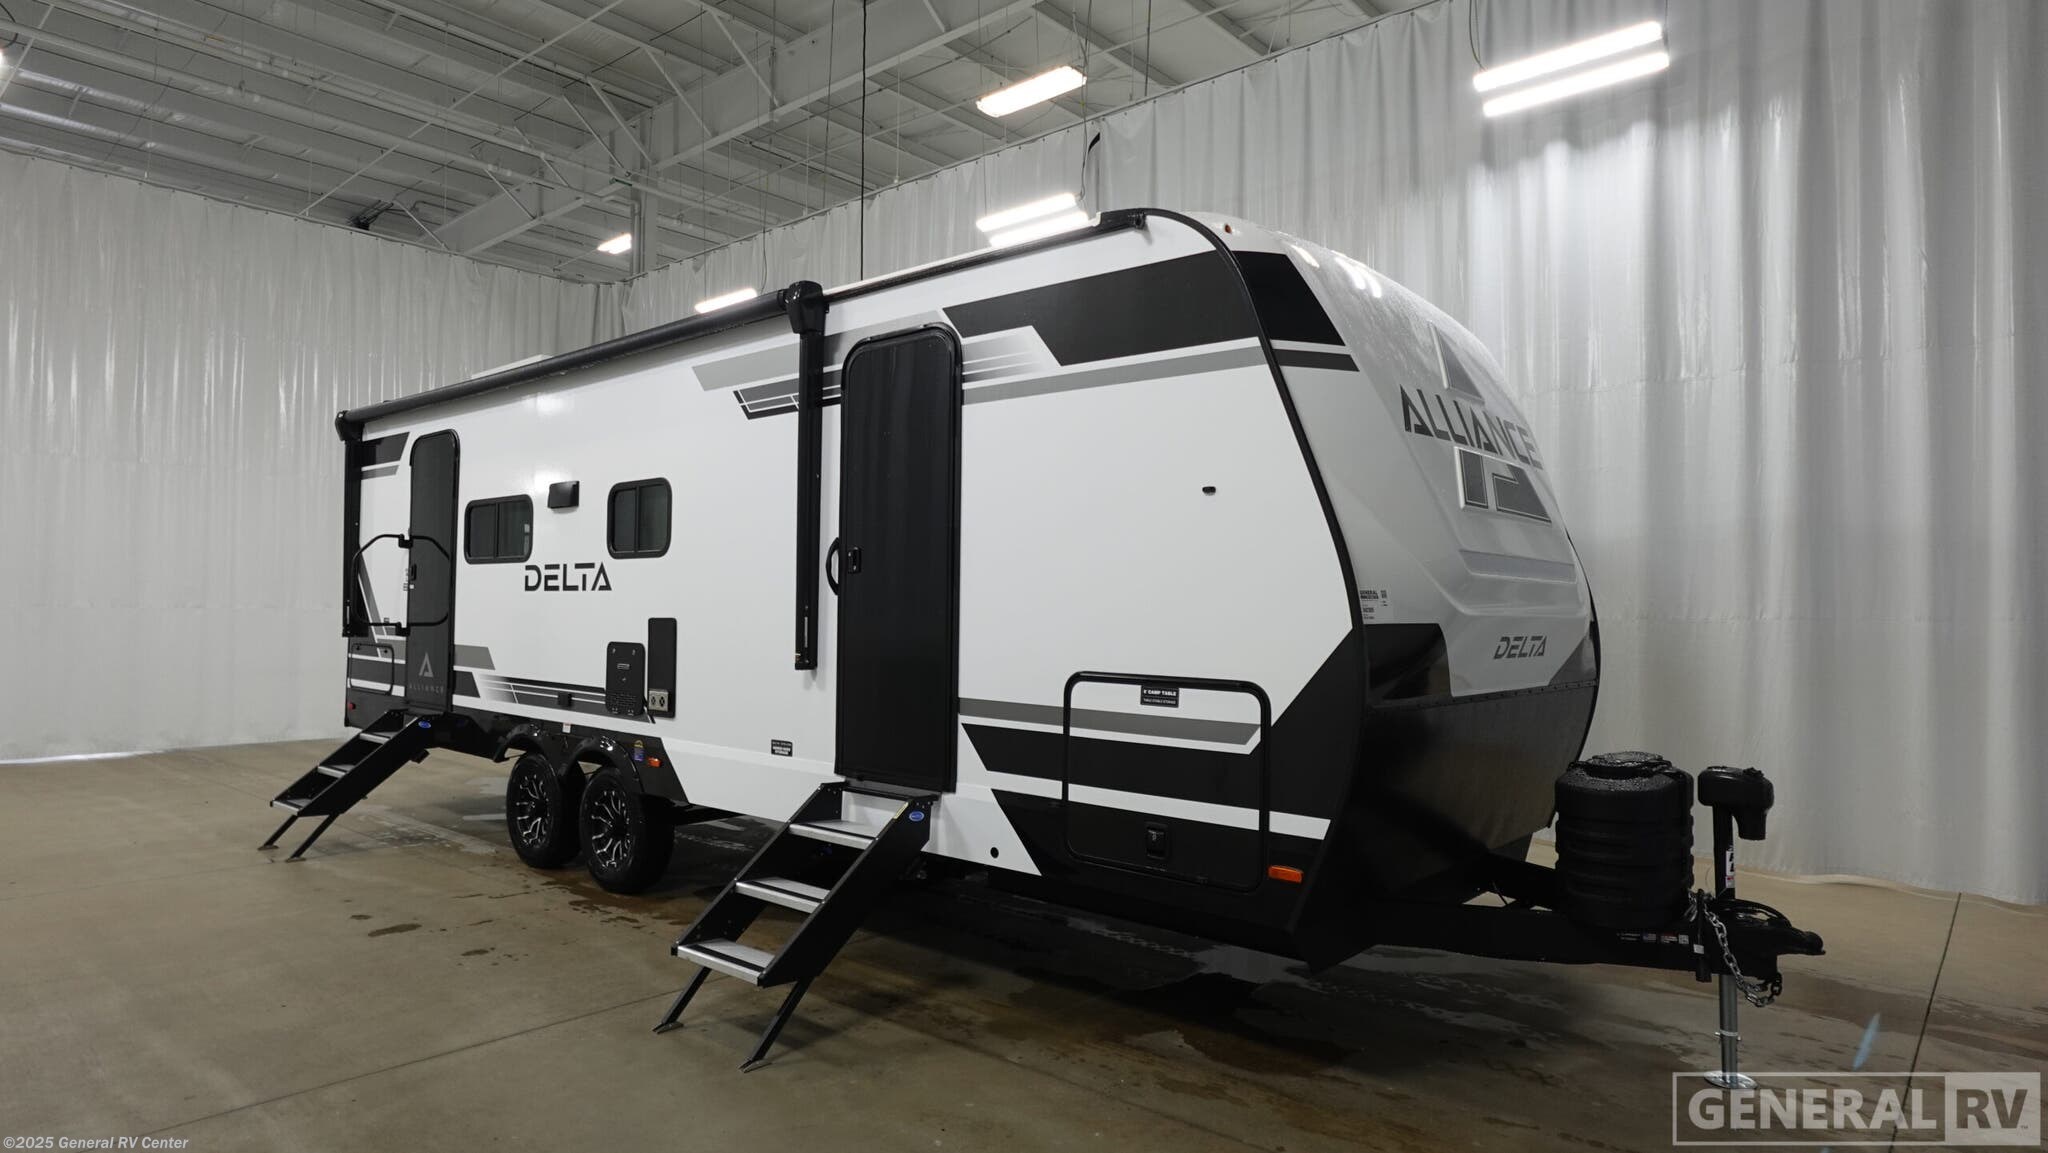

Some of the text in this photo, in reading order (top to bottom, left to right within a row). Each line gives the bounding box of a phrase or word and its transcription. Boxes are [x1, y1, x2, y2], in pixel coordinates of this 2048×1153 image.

[1400, 383, 1543, 471] ALLIANCE
[524, 562, 612, 591] DELTA
[1494, 635, 1547, 659] DELTA
